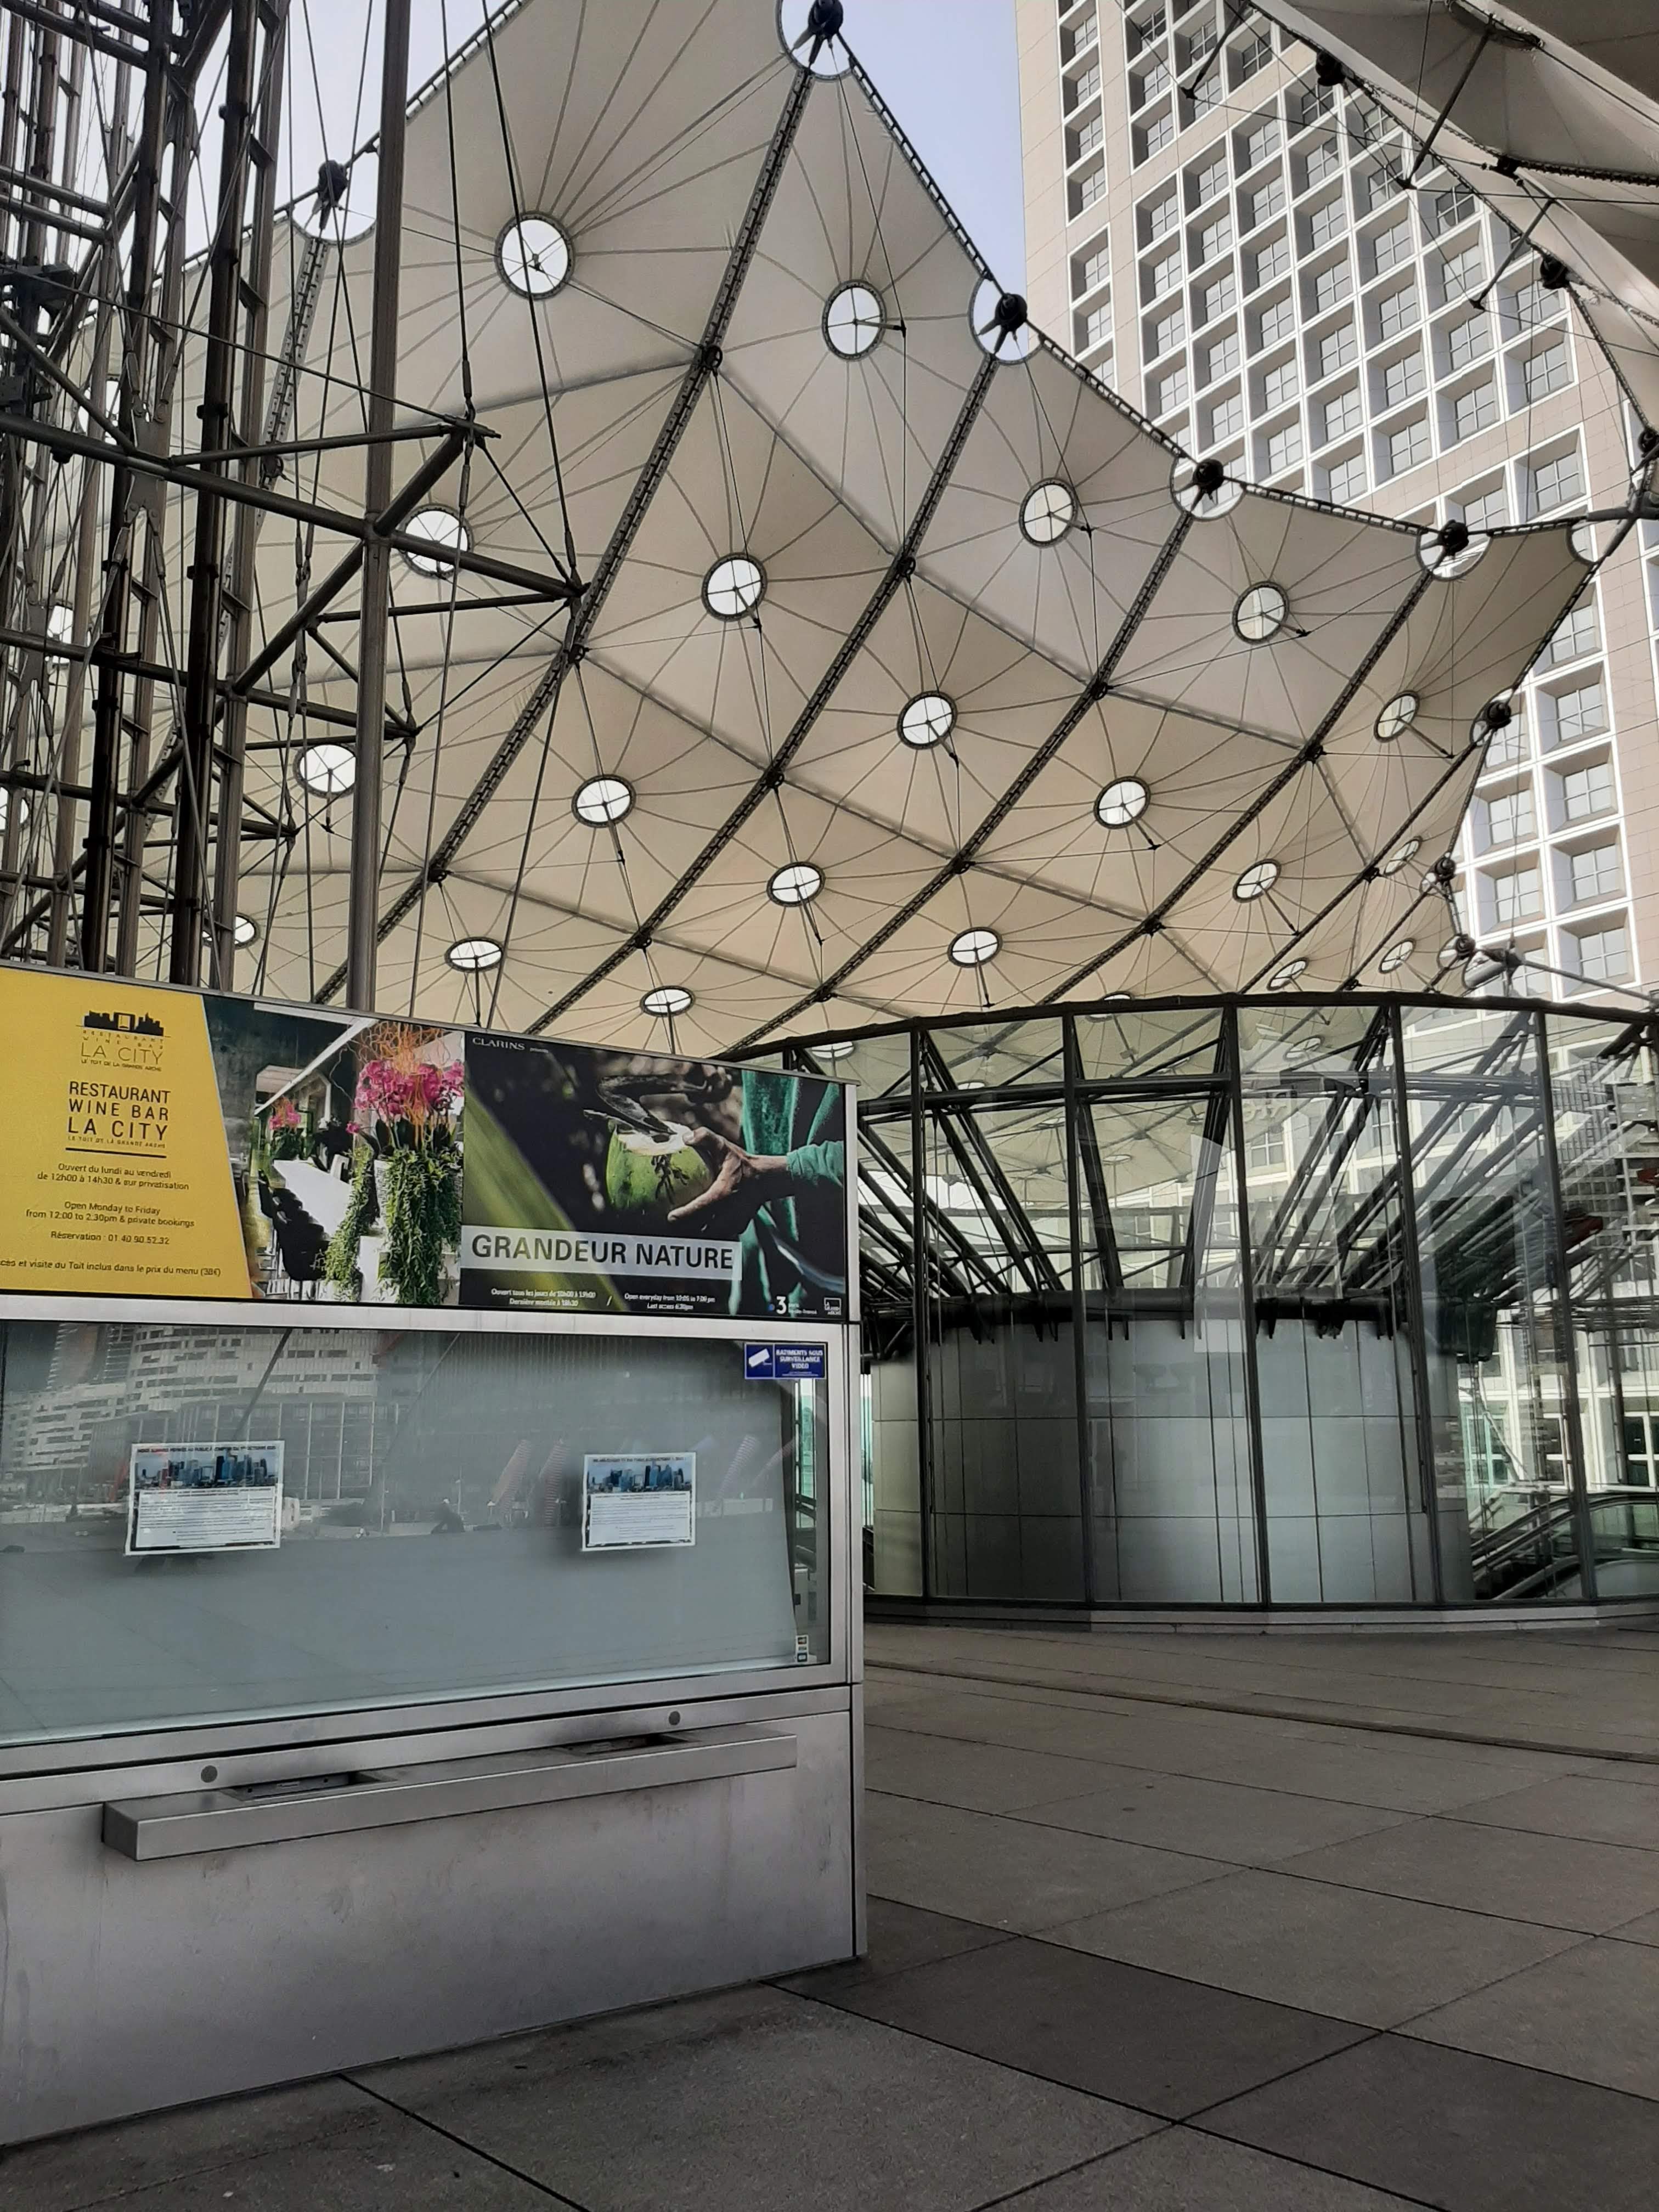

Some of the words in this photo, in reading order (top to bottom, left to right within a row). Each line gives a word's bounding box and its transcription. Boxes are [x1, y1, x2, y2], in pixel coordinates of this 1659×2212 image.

[81, 1042, 106, 1058] LA
[118, 1047, 163, 1064] CITY
[472, 1037, 526, 1051] CLARINS
[70, 1081, 171, 1104] RESTAURANT
[69, 1098, 120, 1116] WINE
[132, 1104, 168, 1121] BAR
[68, 1116, 97, 1135] LA
[112, 1120, 167, 1141] CITY
[58, 1163, 87, 1172] Ouvert
[101, 1166, 122, 1175] lundi
[137, 1170, 171, 1178] vendredi
[37, 1171, 48, 1180] de
[52, 1173, 77, 1181] 12h00
[88, 1176, 113, 1184] 14h30
[139, 1181, 189, 1189] privatisation
[64, 1201, 87, 1210] Open
[89, 1203, 122, 1214] Monday
[136, 1206, 161, 1216] Friday
[26, 1209, 47, 1218] from
[127, 1216, 155, 1224] private
[158, 1218, 195, 1228] bookings
[51, 1231, 101, 1240] Réservation
[472, 1234, 626, 1263] GRANDEUR
[636, 1243, 733, 1269] NATURE
[0, 1259, 16, 1267] cès
[30, 1258, 53, 1268] visite
[69, 1261, 84, 1269] Toit
[87, 1262, 111, 1271] inclus
[114, 1263, 134, 1272] dans
[137, 1264, 144, 1272] le
[146, 1266, 161, 1274] prix
[776, 1296, 787, 1314] 3
